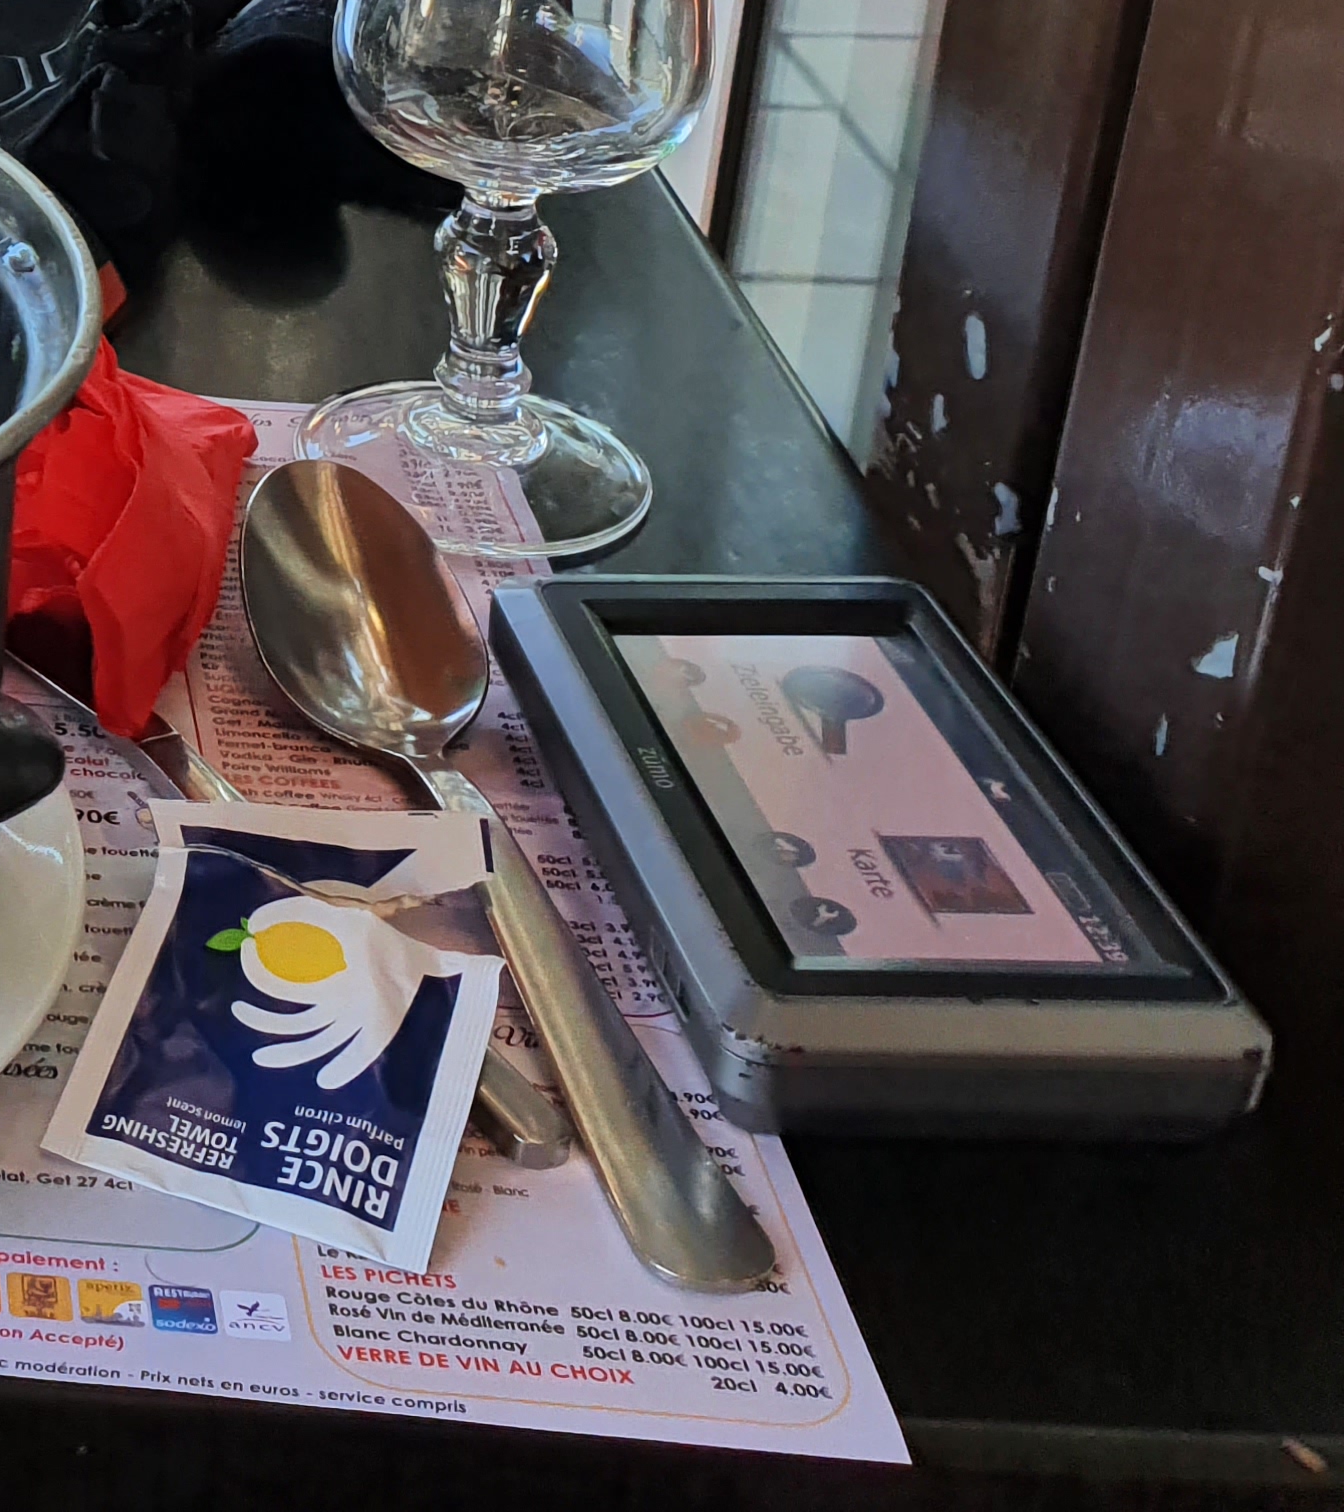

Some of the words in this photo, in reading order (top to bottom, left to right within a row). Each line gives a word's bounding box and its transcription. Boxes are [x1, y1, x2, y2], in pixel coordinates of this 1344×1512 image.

[730, 662, 805, 758] Zieleingabe
[220, 749, 272, 762] Vodka
[221, 760, 262, 772] Poire
[264, 763, 331, 777] Williams
[846, 847, 894, 900] Karte
[165, 1095, 203, 1116] scent
[204, 1108, 248, 1134] lemon
[294, 1104, 344, 1125] citron
[102, 1114, 235, 1170] REFRESHING
[169, 1114, 238, 1155] TOWEL
[344, 1115, 405, 1151] parfum
[260, 1120, 399, 1188] DOIGTS
[36, 1173, 71, 1187] Get
[276, 1154, 390, 1220] RINCE
[320, 1264, 358, 1281] LES
[364, 1268, 457, 1289] PICHETS
[154, 1318, 217, 1331] sodexo
[228, 1321, 286, 1333] ancv
[325, 1286, 391, 1304] Rouge
[396, 1290, 456, 1308] Côtes
[461, 1297, 488, 1311] du
[494, 1298, 559, 1317] Rhône
[571, 1305, 613, 1322] 50cl
[619, 1310, 673, 1327] 8.00€
[678, 1314, 734, 1332] 100cl
[740, 1319, 810, 1338] 15.00€
[328, 1302, 372, 1319] Rosé
[375, 1306, 406, 1323] Vin
[411, 1310, 436, 1325] de
[440, 1312, 566, 1335] Méditerranée
[576, 1324, 620, 1341] 50cl
[625, 1329, 680, 1347] 8.00€
[685, 1334, 741, 1352] 100cl
[747, 1339, 817, 1358] 15.00€
[30, 1328, 125, 1351] Accepté)
[333, 1324, 392, 1341] Blanc
[397, 1329, 528, 1355] Chardonnay
[582, 1345, 626, 1362] 50cl
[631, 1349, 688, 1368] 8.00€
[693, 1353, 749, 1373] 100cl
[755, 1359, 825, 1379] 15.00€
[15, 1358, 122, 1380] modération
[140, 1370, 172, 1384] Prix
[177, 1375, 215, 1389] nets
[249, 1383, 300, 1398] euros
[318, 1390, 386, 1406] service
[391, 1394, 467, 1414] compris
[336, 1344, 413, 1365] VERRE
[418, 1349, 450, 1369] DE
[455, 1354, 501, 1373] VIN
[509, 1359, 542, 1377] AU
[551, 1364, 636, 1385] CHOIX
[711, 1375, 758, 1393] 20cl
[774, 1381, 833, 1400] 4.00€
